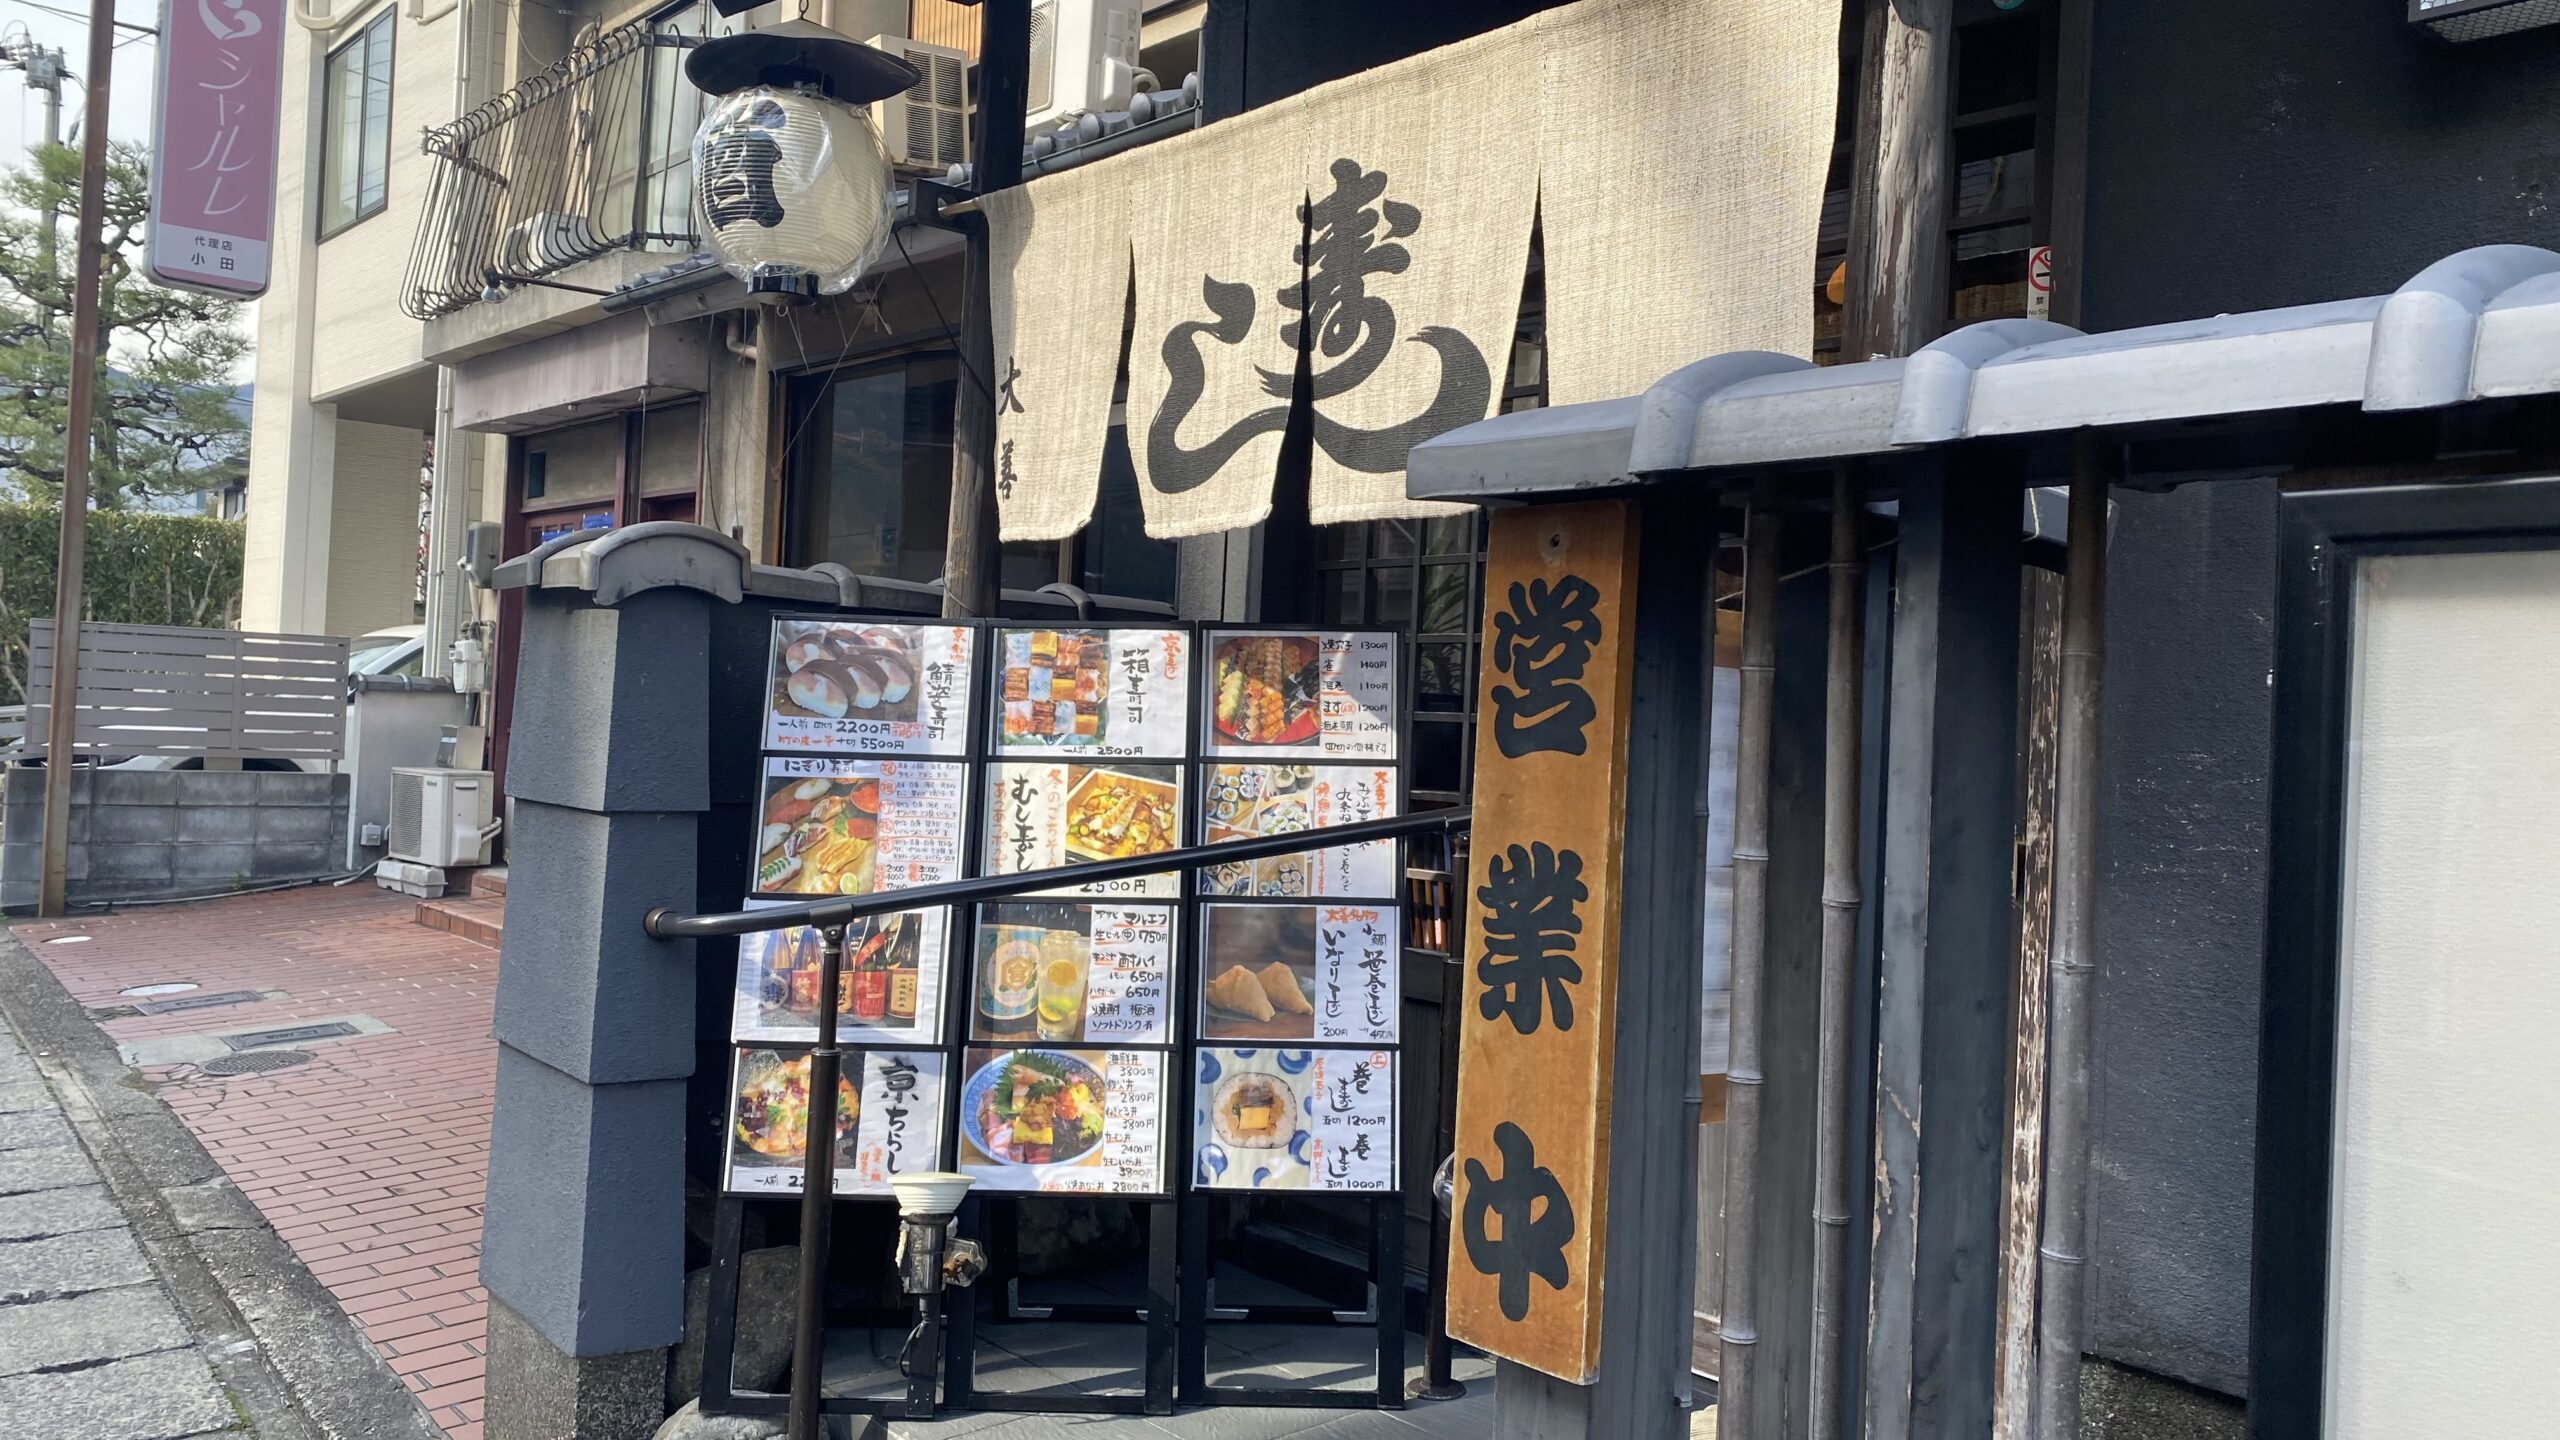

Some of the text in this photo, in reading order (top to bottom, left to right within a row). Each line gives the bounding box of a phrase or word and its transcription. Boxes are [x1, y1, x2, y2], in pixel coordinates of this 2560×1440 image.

[186, 48, 255, 215] シャルレ
[194, 235, 233, 251] 代理店
[190, 252, 235, 271] 小田
[1360, 641, 1388, 650] 1300円
[1120, 648, 1151, 725] 箱寿司
[836, 720, 891, 735] 2200円
[1359, 722, 1388, 732] 1200円
[860, 737, 905, 750] 5500円
[1097, 746, 1143, 755] 2500円
[1123, 911, 1168, 926] マルエフ
[1138, 929, 1168, 944] 750円
[1463, 575, 1602, 1322] 営業中
[1118, 951, 1156, 968] 酎ハイ
[1130, 970, 1163, 983] 650円
[1125, 985, 1160, 999] 650円
[1323, 1027, 1348, 1037] 200円
[1119, 1066, 1155, 1077] 3800円
[1120, 1092, 1155, 1103] 2800円
[880, 1056, 919, 1175] 京ちらし
[1347, 1114, 1387, 1127] 1200円
[1122, 1118, 1155, 1130] 3800円
[1120, 1144, 1153, 1155] 2400円
[1118, 1166, 1153, 1178] 3800円
[1112, 1181, 1150, 1193] 2800円
[1347, 1179, 1385, 1190] 1000円
